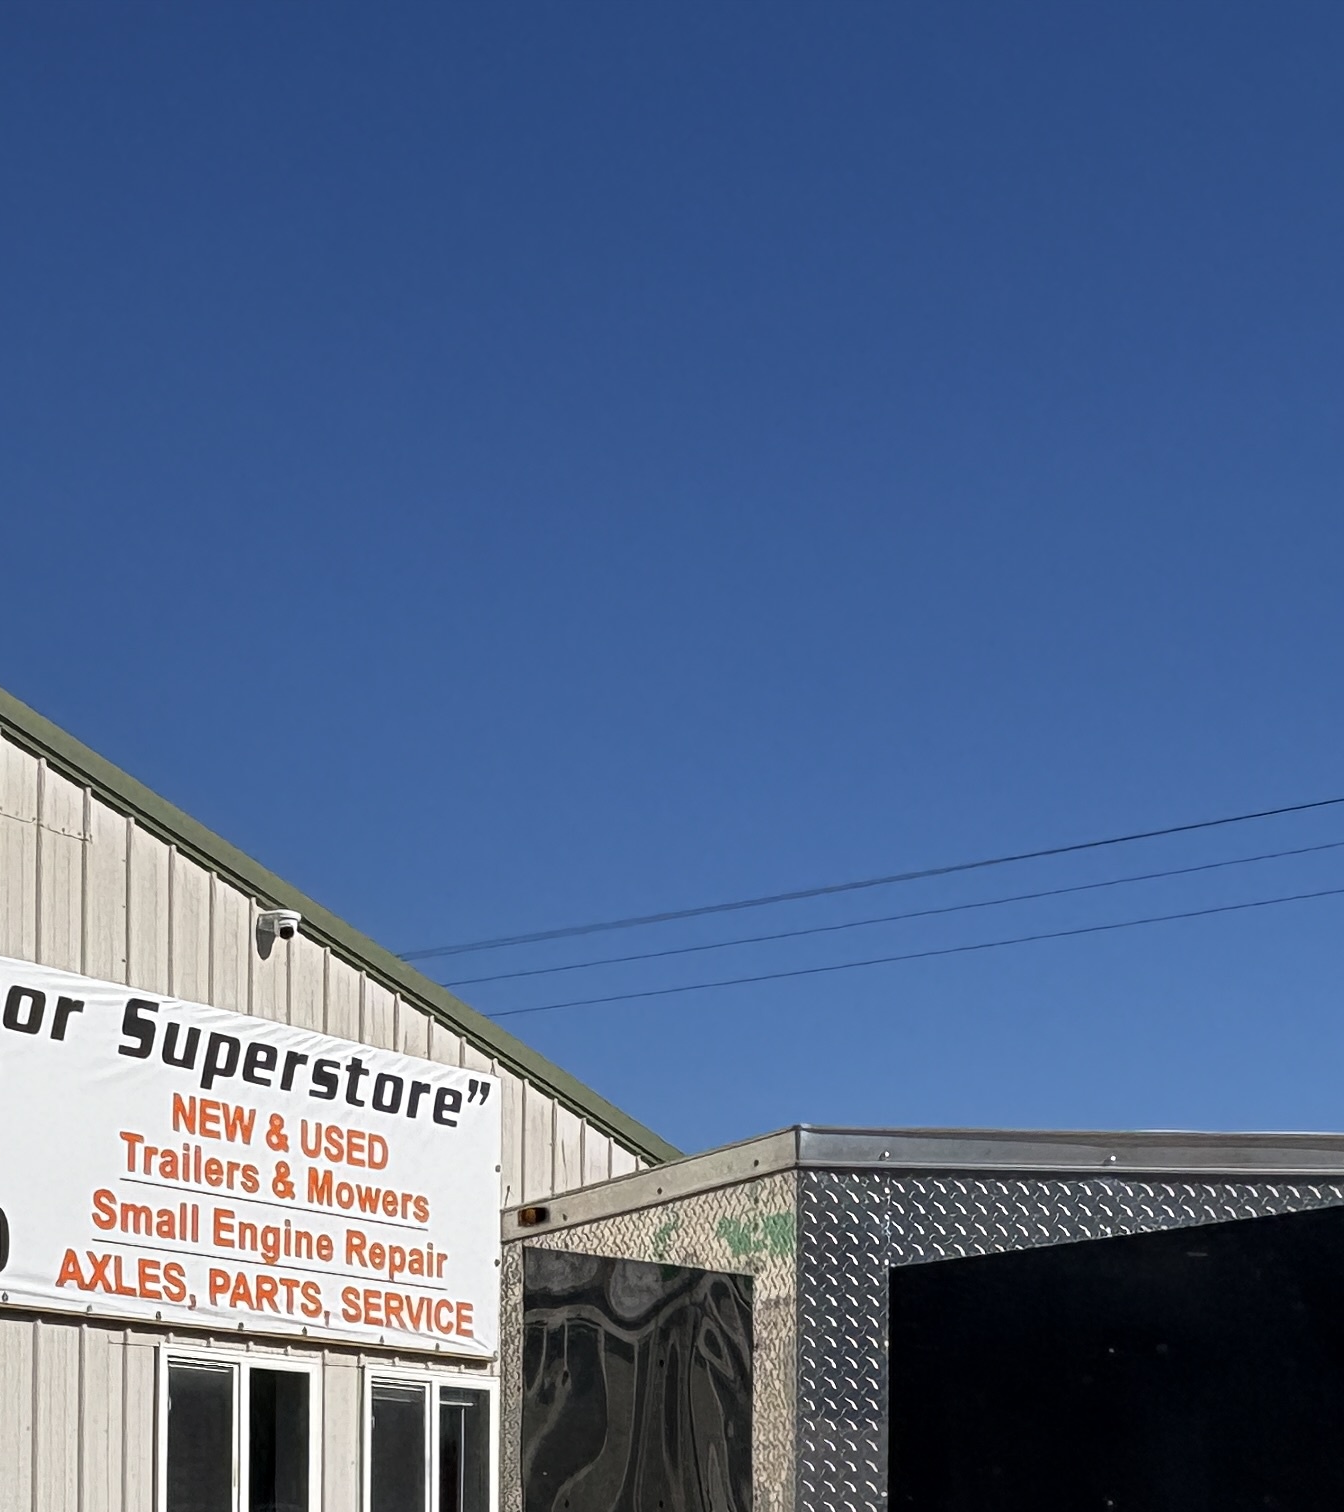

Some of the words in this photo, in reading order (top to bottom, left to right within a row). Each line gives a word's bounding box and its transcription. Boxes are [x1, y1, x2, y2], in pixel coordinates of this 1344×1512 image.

[172, 1092, 256, 1145] NEW
[265, 1113, 290, 1153] &
[301, 1119, 390, 1171] USED
[119, 1131, 260, 1194] Trailers
[271, 1161, 296, 1200] &
[307, 1166, 430, 1223] Mowers
[91, 1189, 200, 1243] Small
[212, 1208, 334, 1267] Engine
[345, 1230, 448, 1281] Repair
[55, 1249, 198, 1310] AXLES,
[208, 1268, 331, 1328] PARTS,
[341, 1286, 474, 1338] SERVICE
